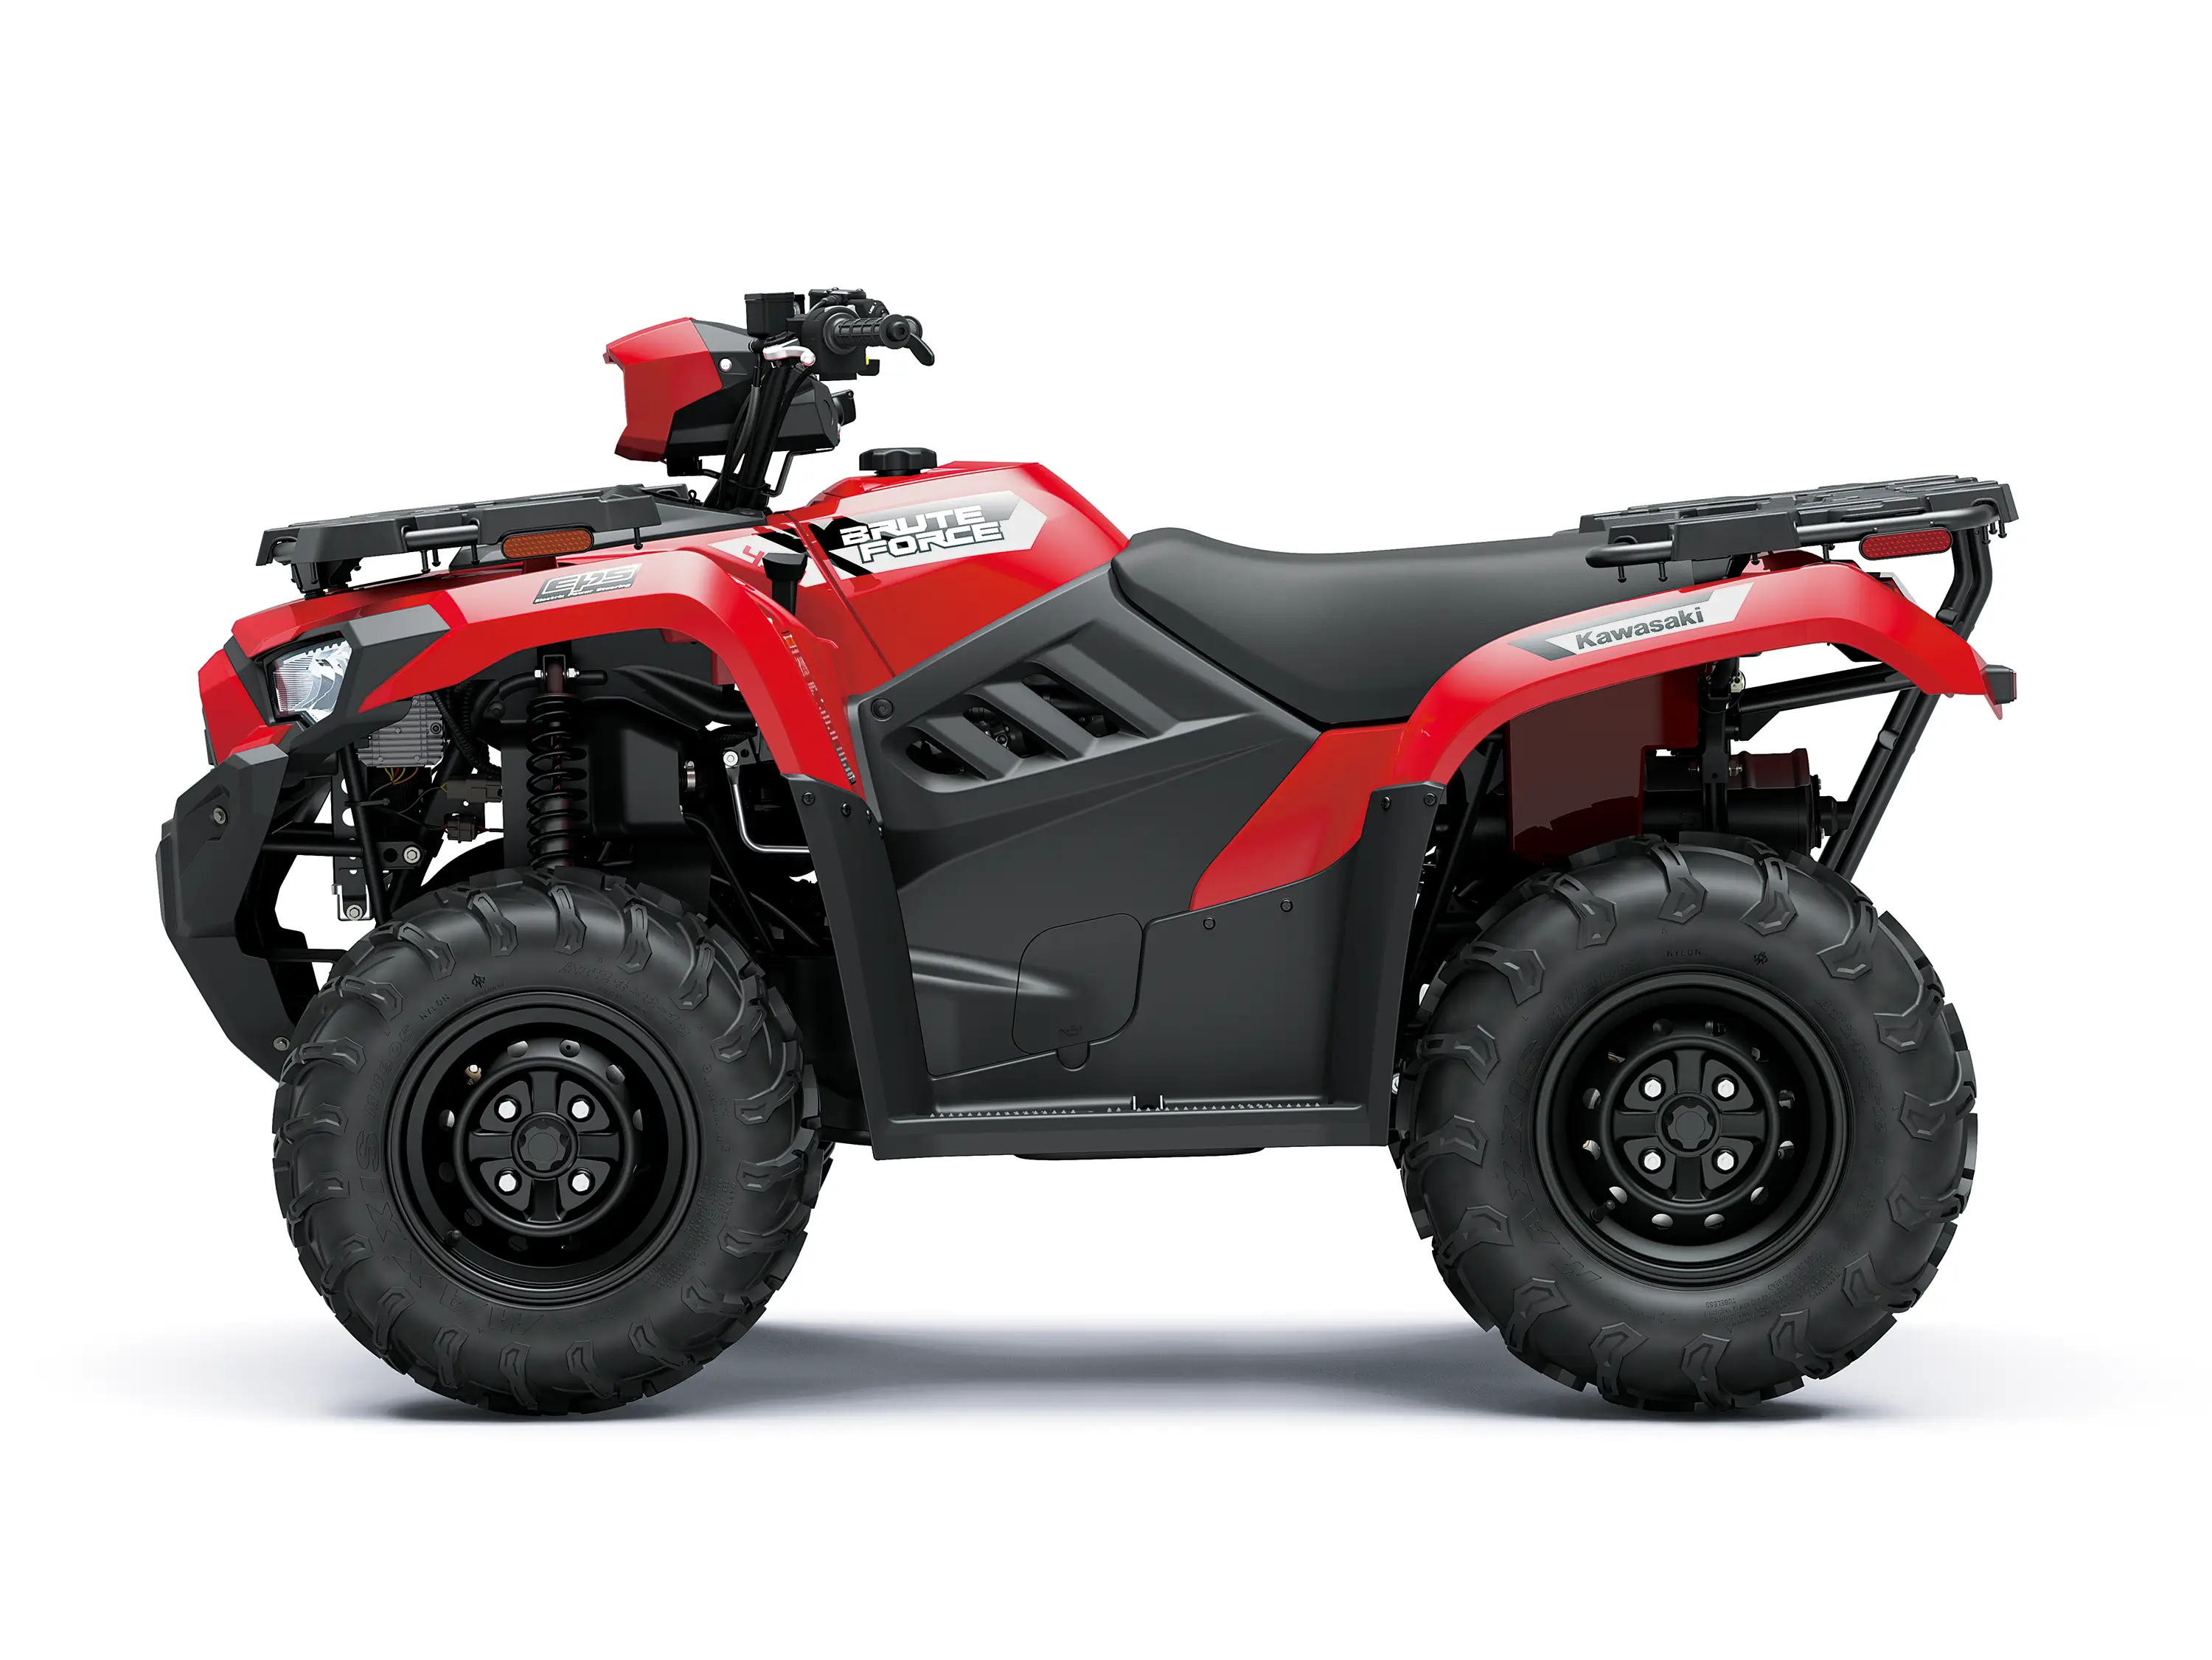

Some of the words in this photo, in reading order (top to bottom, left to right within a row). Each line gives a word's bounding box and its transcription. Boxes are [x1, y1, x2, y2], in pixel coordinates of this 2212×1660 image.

[840, 505, 985, 545] BRUTE
[858, 521, 1004, 564] FORCE
[1576, 607, 1704, 650] Kawasaki
[417, 992, 451, 1021] NYLON
